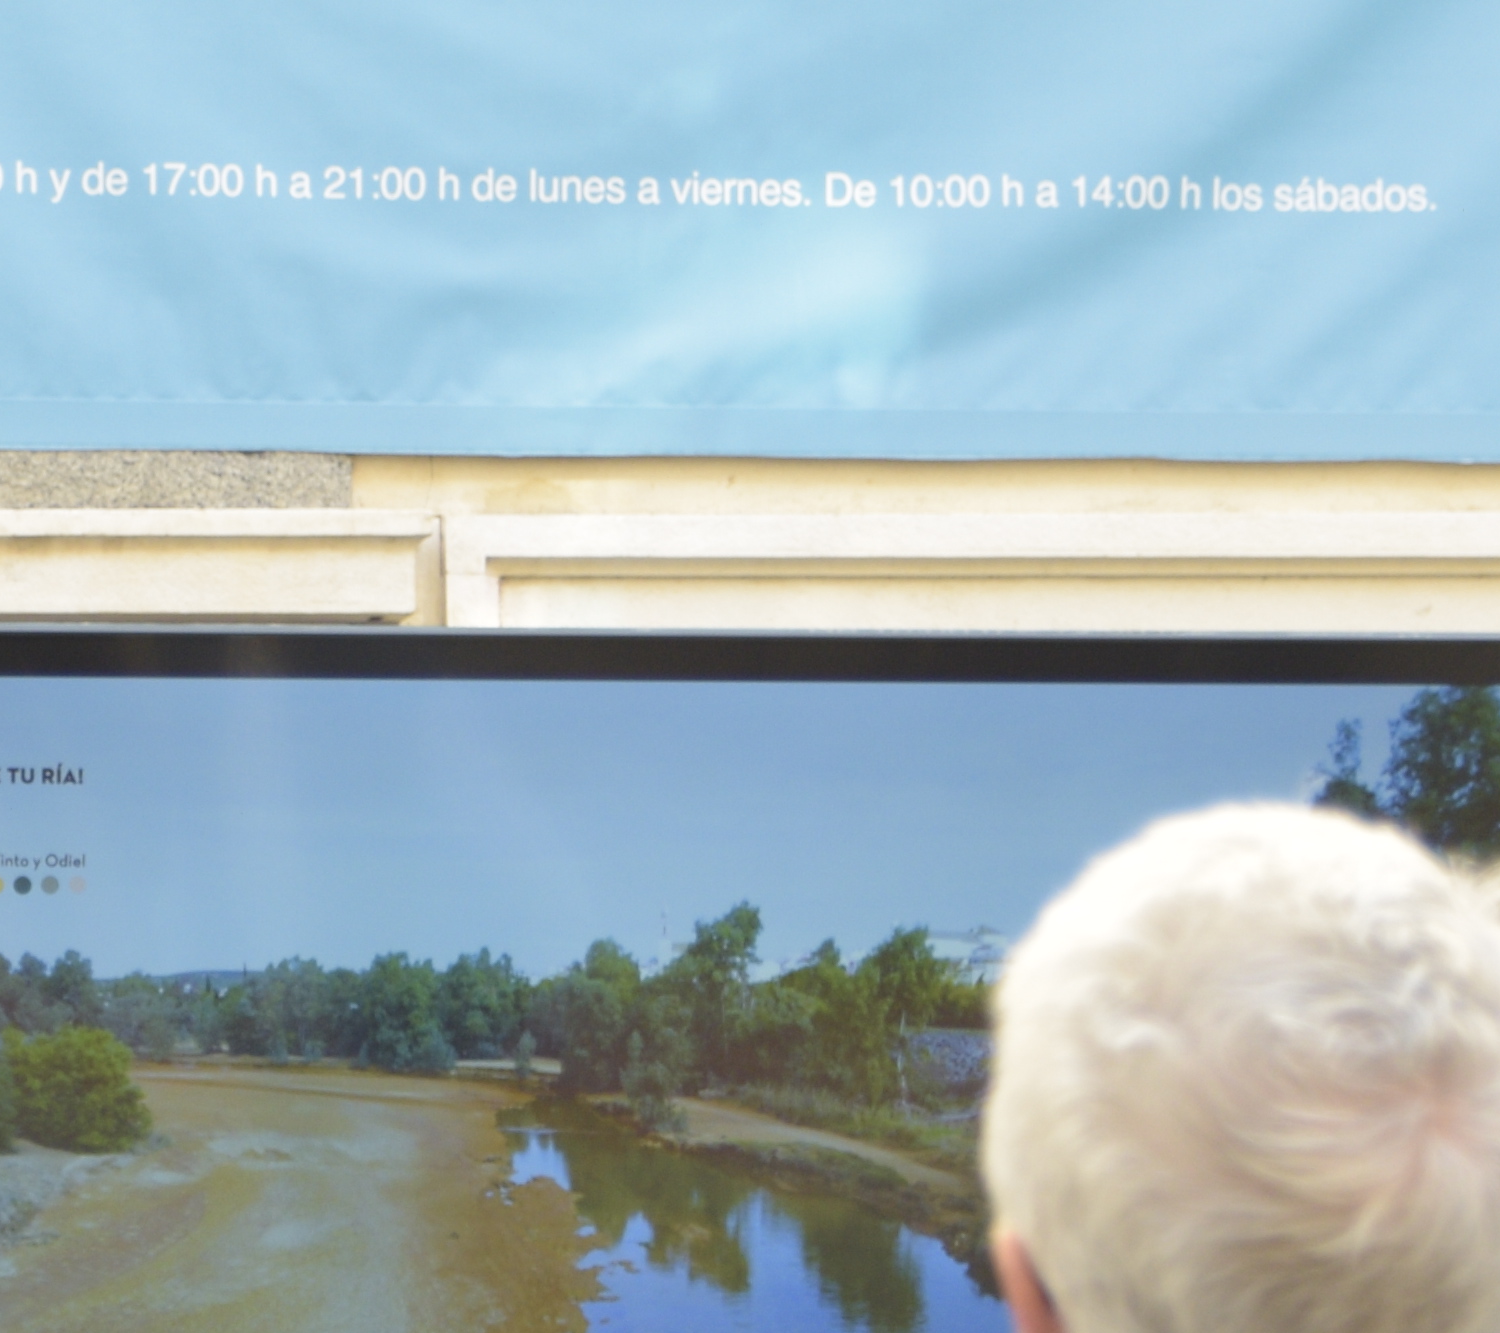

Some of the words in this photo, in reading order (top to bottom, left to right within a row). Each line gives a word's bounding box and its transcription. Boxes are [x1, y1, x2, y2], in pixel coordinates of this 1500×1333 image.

[14, 158, 39, 196] h
[47, 167, 73, 205] y
[80, 159, 130, 198] de
[141, 160, 246, 199] 17:00
[254, 162, 279, 199] h
[287, 169, 314, 201] a
[322, 163, 428, 202] 21:00
[437, 165, 462, 202] h
[469, 166, 519, 204] de
[528, 166, 628, 206] lunes
[635, 175, 662, 206] a
[669, 169, 812, 209] viernes.
[823, 170, 878, 209] De
[889, 172, 992, 209] 10:00
[1000, 172, 1026, 209] h
[1034, 178, 1061, 210] a
[1070, 173, 1171, 211] 14:00
[1179, 174, 1203, 211] h
[1211, 174, 1265, 213] los
[1272, 175, 1438, 214] sábados.
[6, 766, 35, 785] TU
[41, 762, 84, 785] RÍA!
[32, 857, 41, 871] y
[44, 851, 86, 869] Odiel
